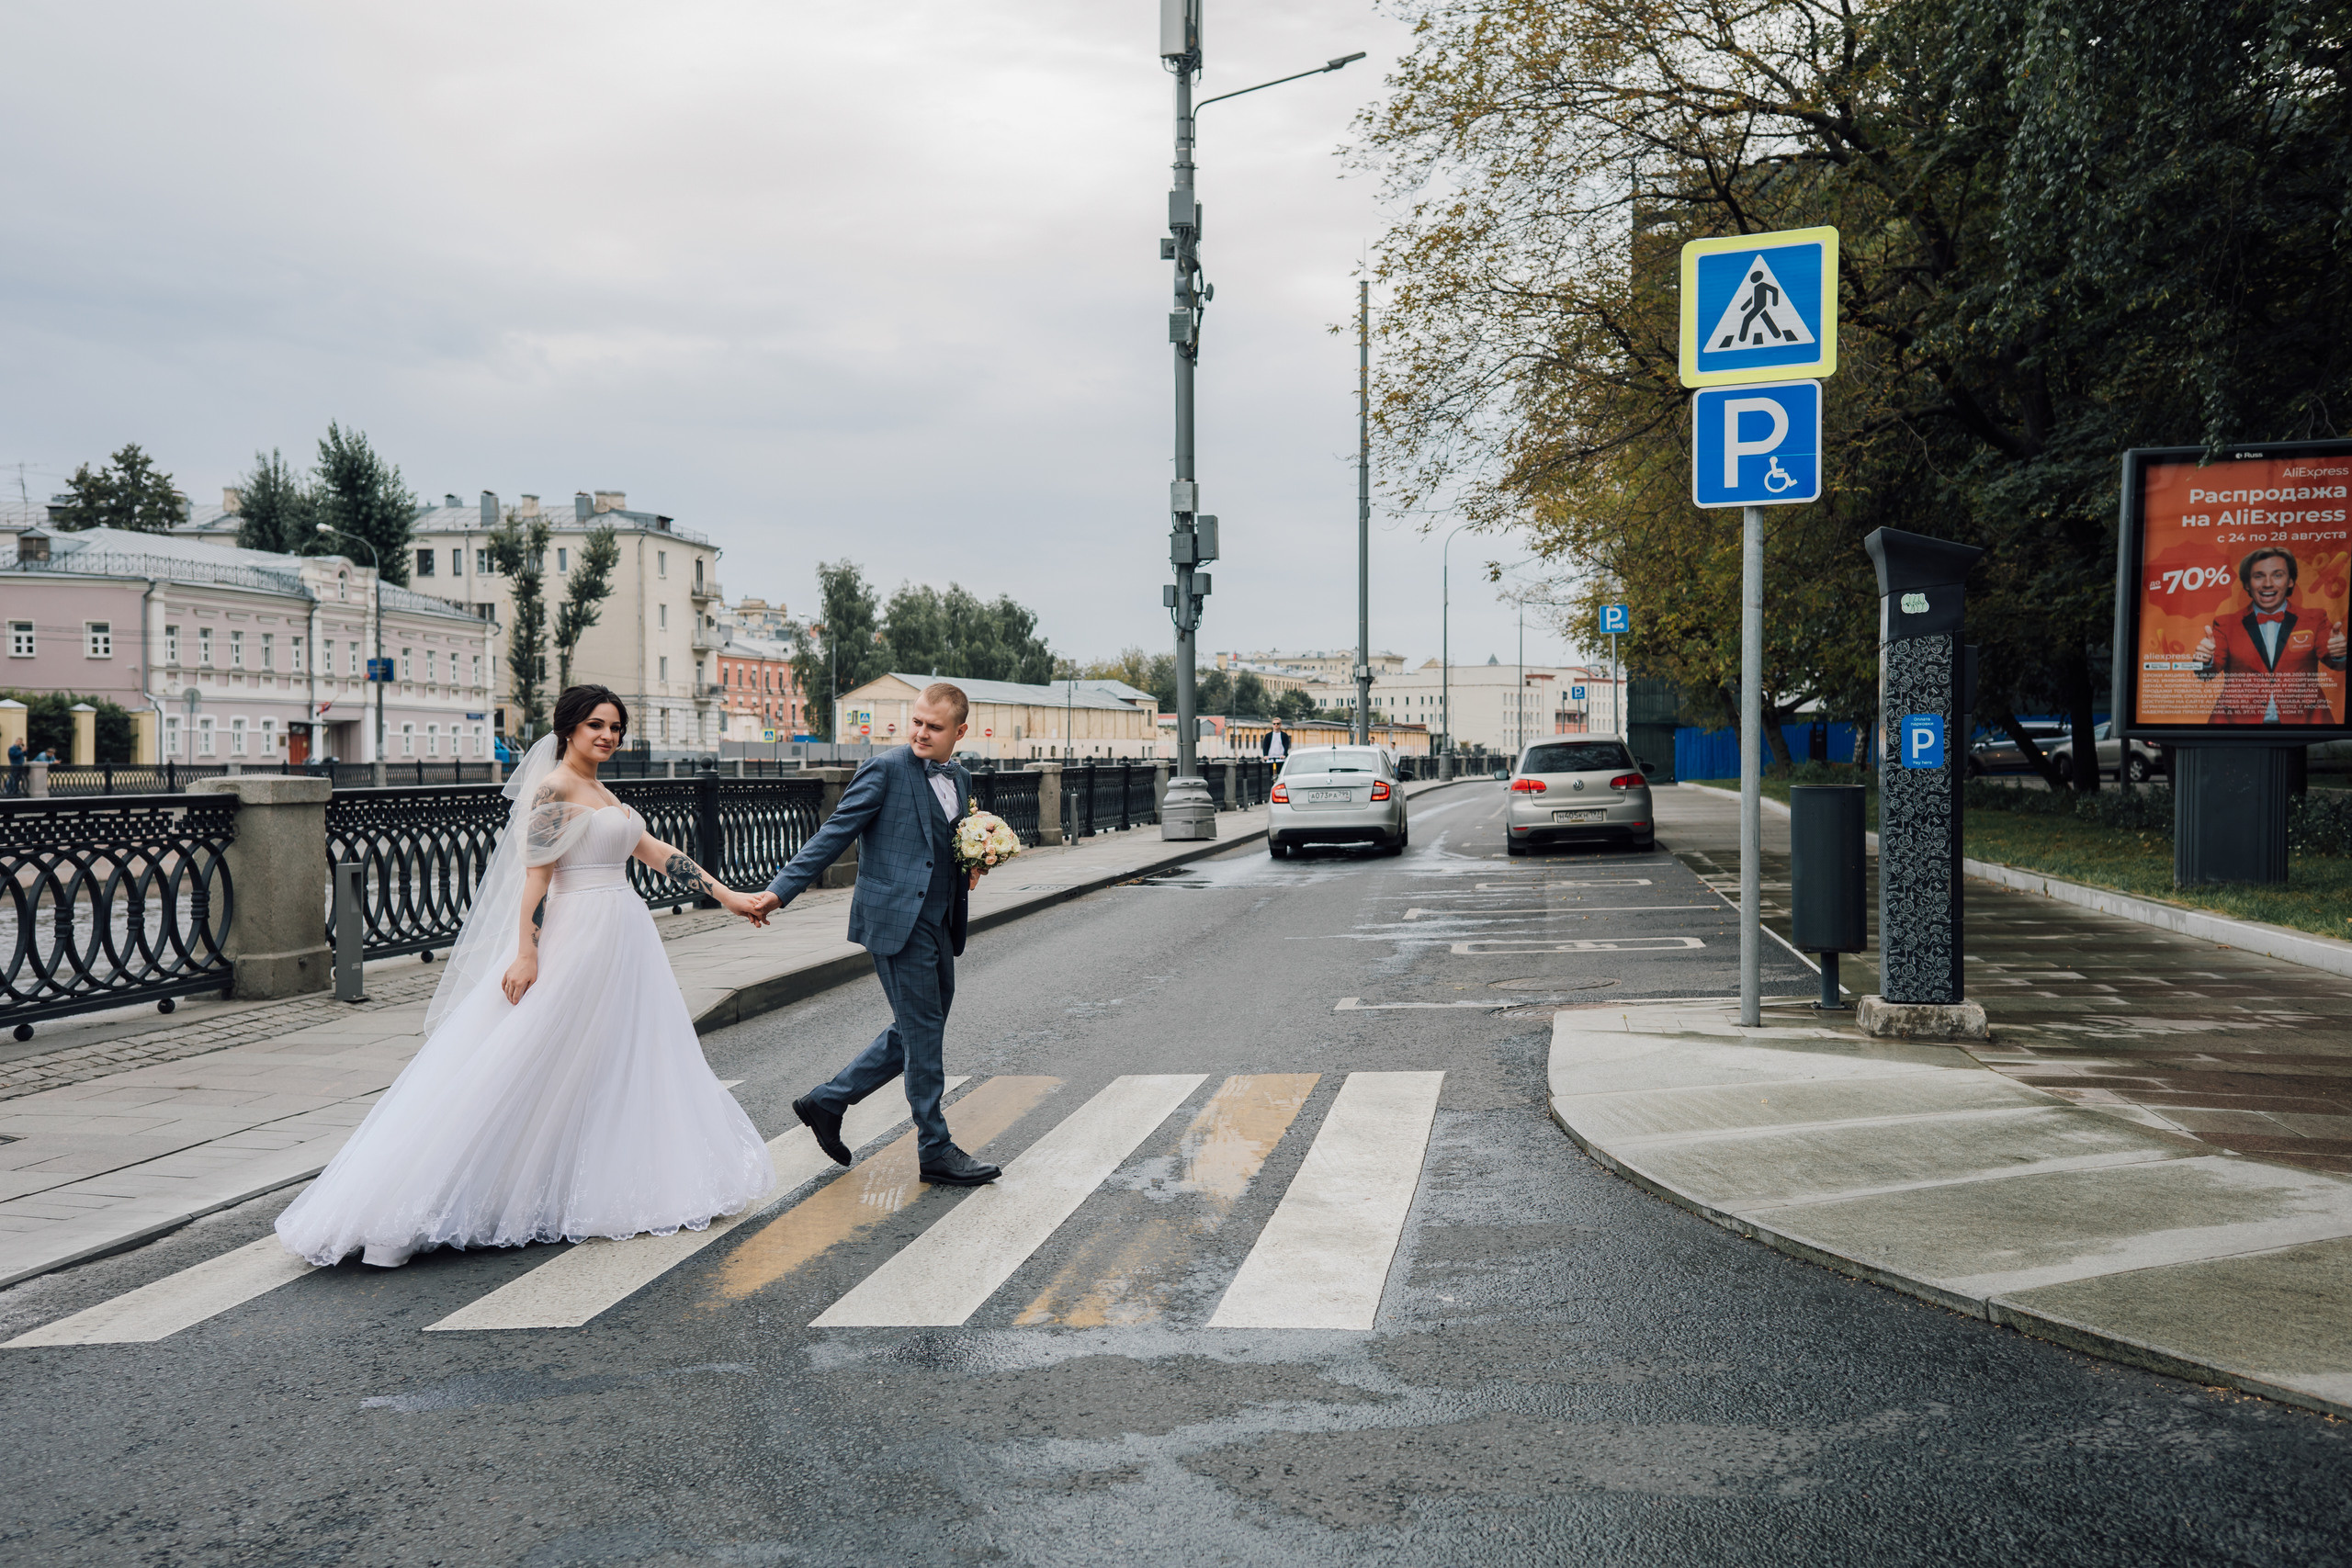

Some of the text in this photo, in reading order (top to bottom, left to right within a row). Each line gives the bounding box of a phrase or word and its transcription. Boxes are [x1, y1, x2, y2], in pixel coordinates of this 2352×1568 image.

[1724, 397, 1790, 489] P
[2282, 467, 2349, 479] AliExpress
[2189, 485, 2347, 505] Распродажа
[2182, 509, 2346, 527] на AliExpress
[2217, 531, 2347, 543] с 24 по 28 августа
[2163, 565, 2231, 595] 70%
[1606, 607, 1623, 630] P
[1912, 728, 1935, 759] P
